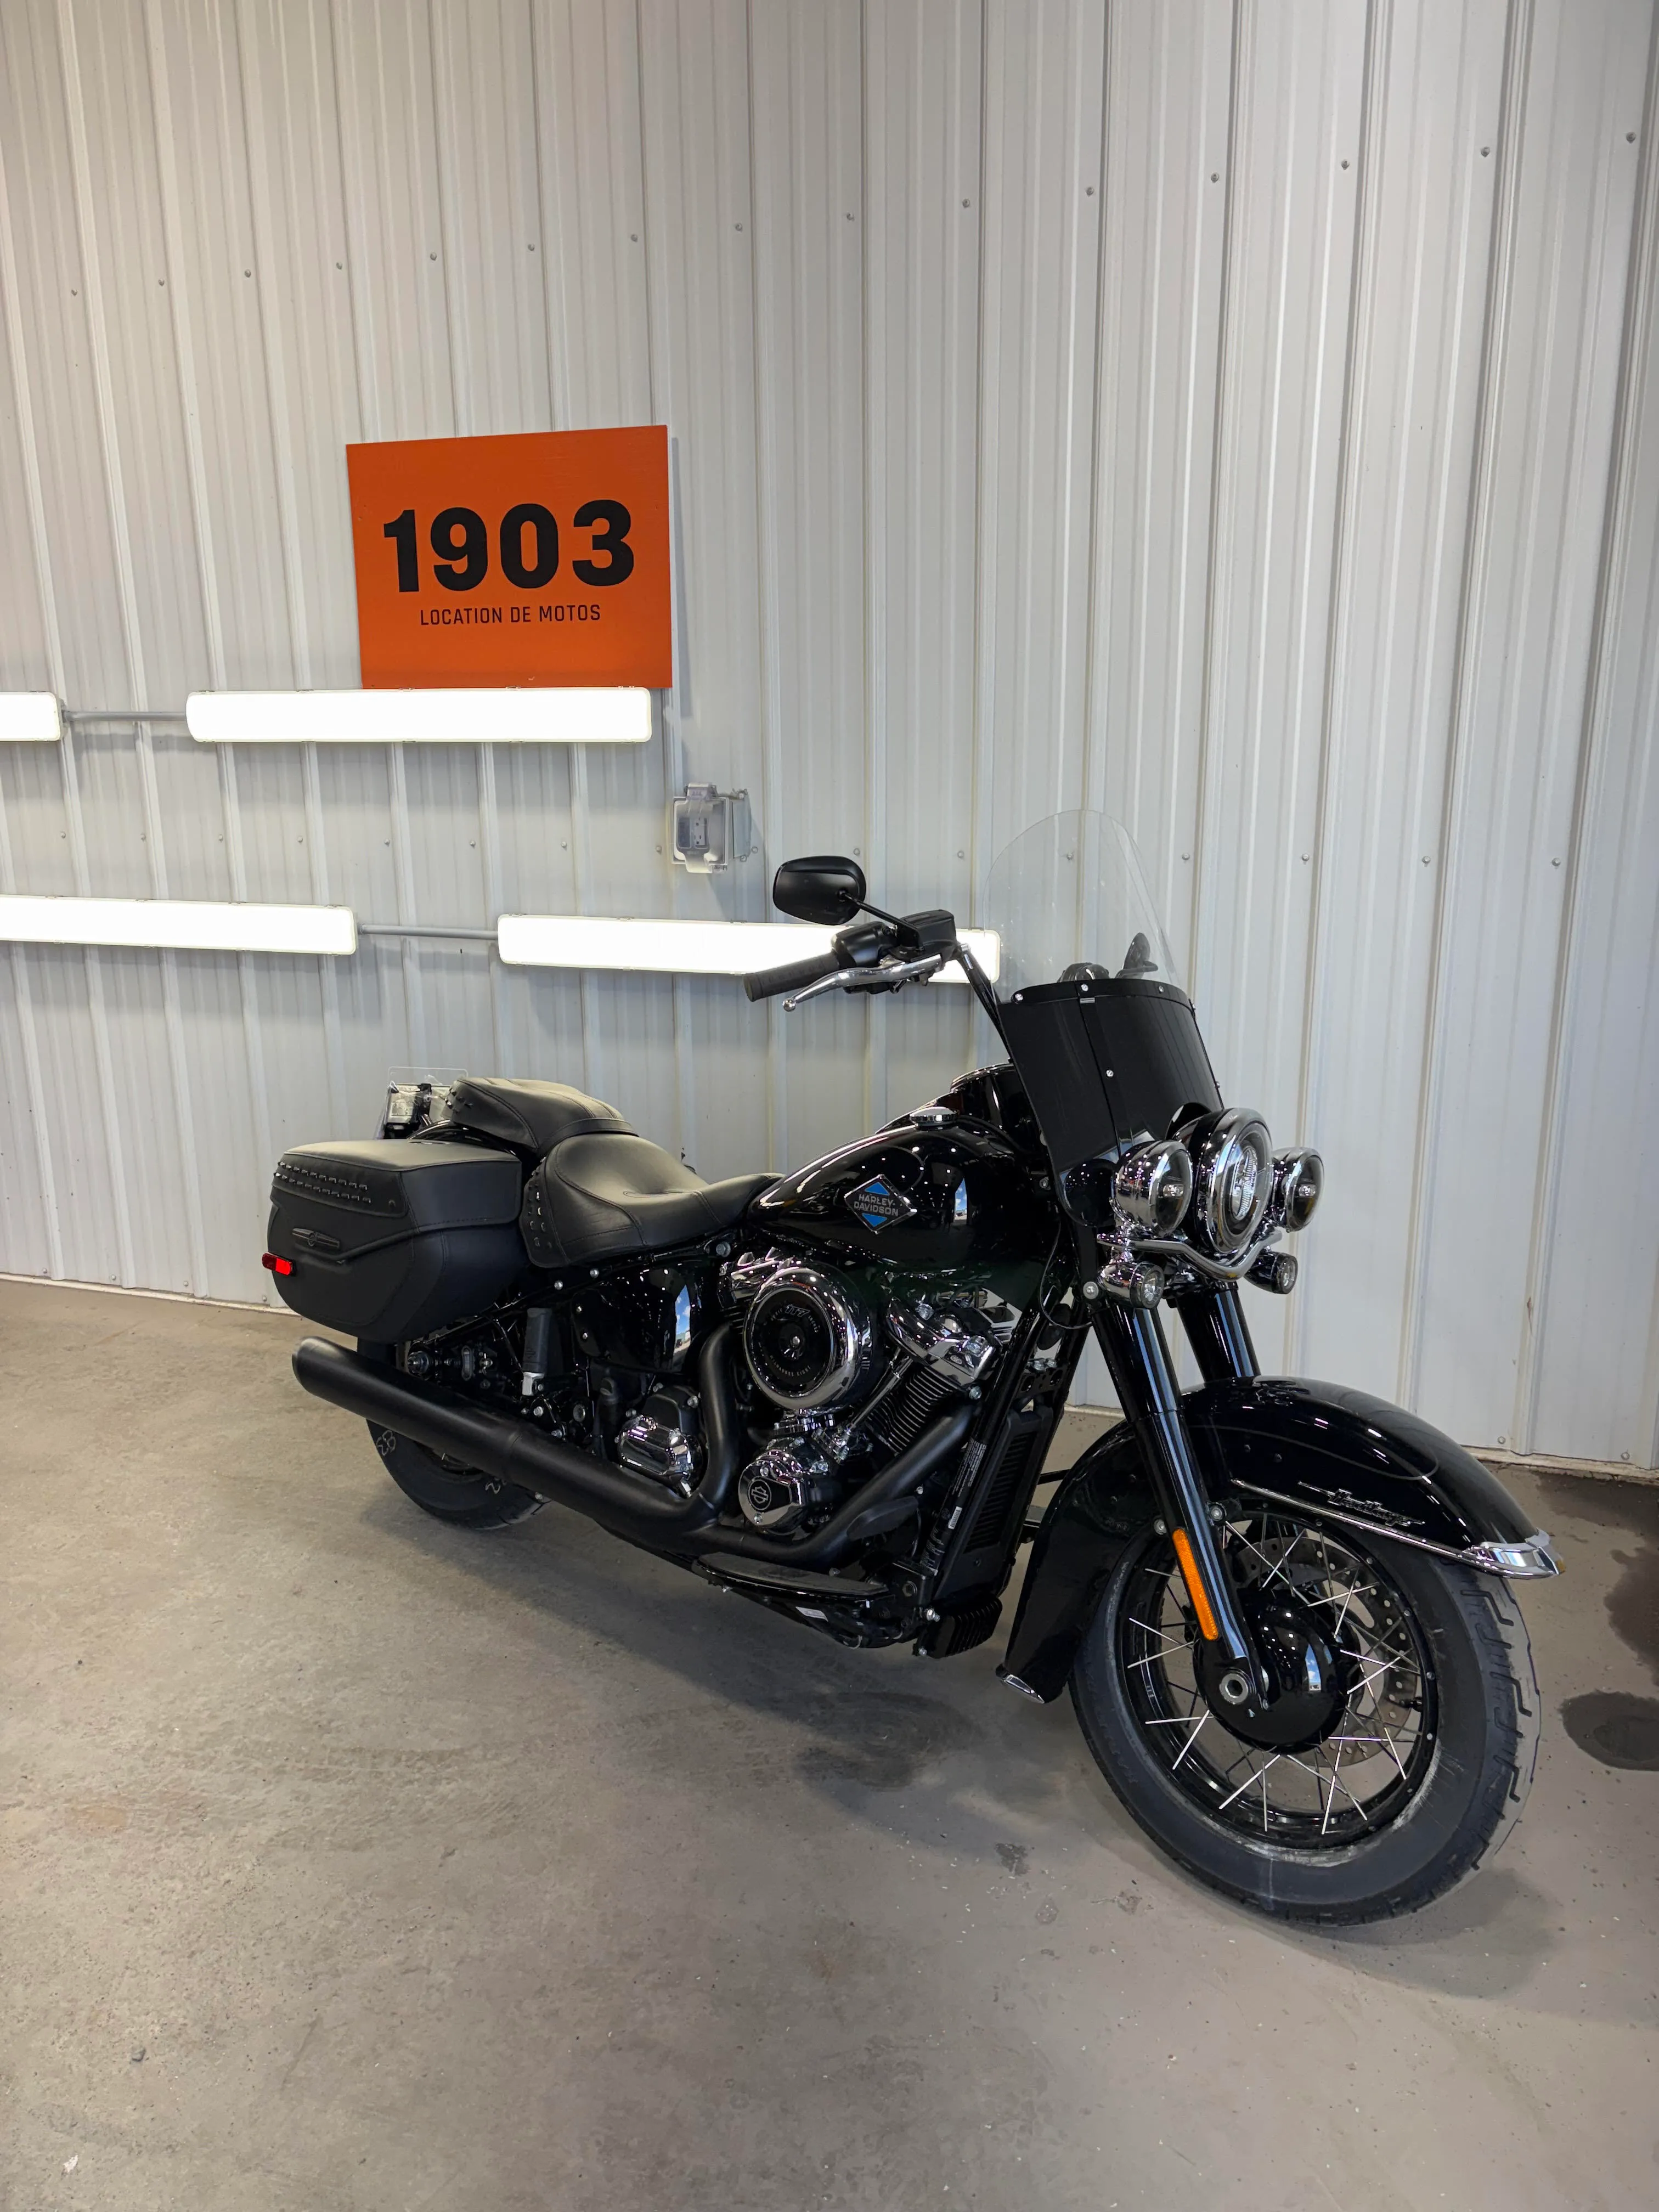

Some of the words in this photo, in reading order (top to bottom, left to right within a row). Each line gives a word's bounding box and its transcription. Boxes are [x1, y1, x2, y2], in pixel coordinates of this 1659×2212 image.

[383, 499, 634, 592] 1903
[420, 607, 502, 625] LOCATION
[511, 606, 531, 623] DE
[539, 604, 601, 623] MOTOS
[854, 1201, 899, 1216] DAVIDSON
[859, 1194, 896, 1206] HARLEY-
